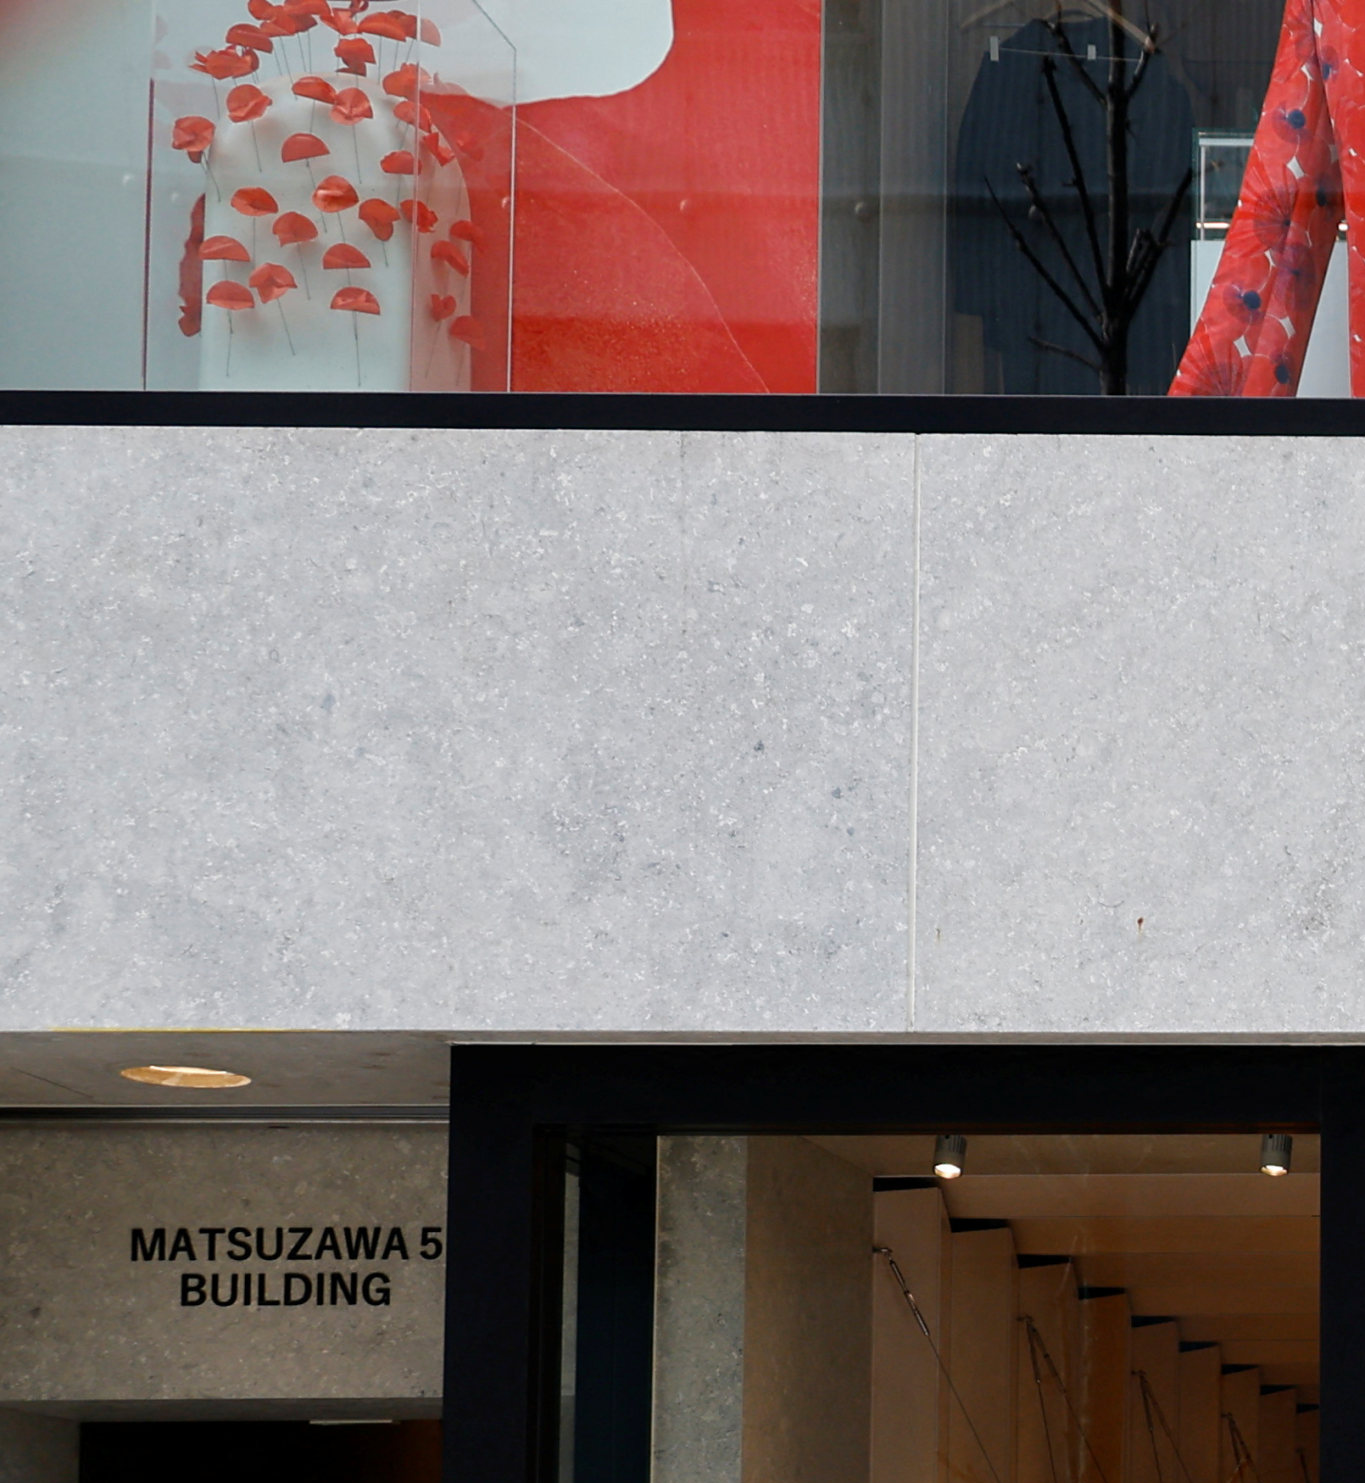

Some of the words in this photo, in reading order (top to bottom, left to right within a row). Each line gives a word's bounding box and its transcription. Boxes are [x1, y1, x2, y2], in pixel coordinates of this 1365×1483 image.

[129, 1226, 409, 1263] MATSUZAWA
[419, 1226, 443, 1261] 5
[180, 1272, 392, 1307] BUILDING
